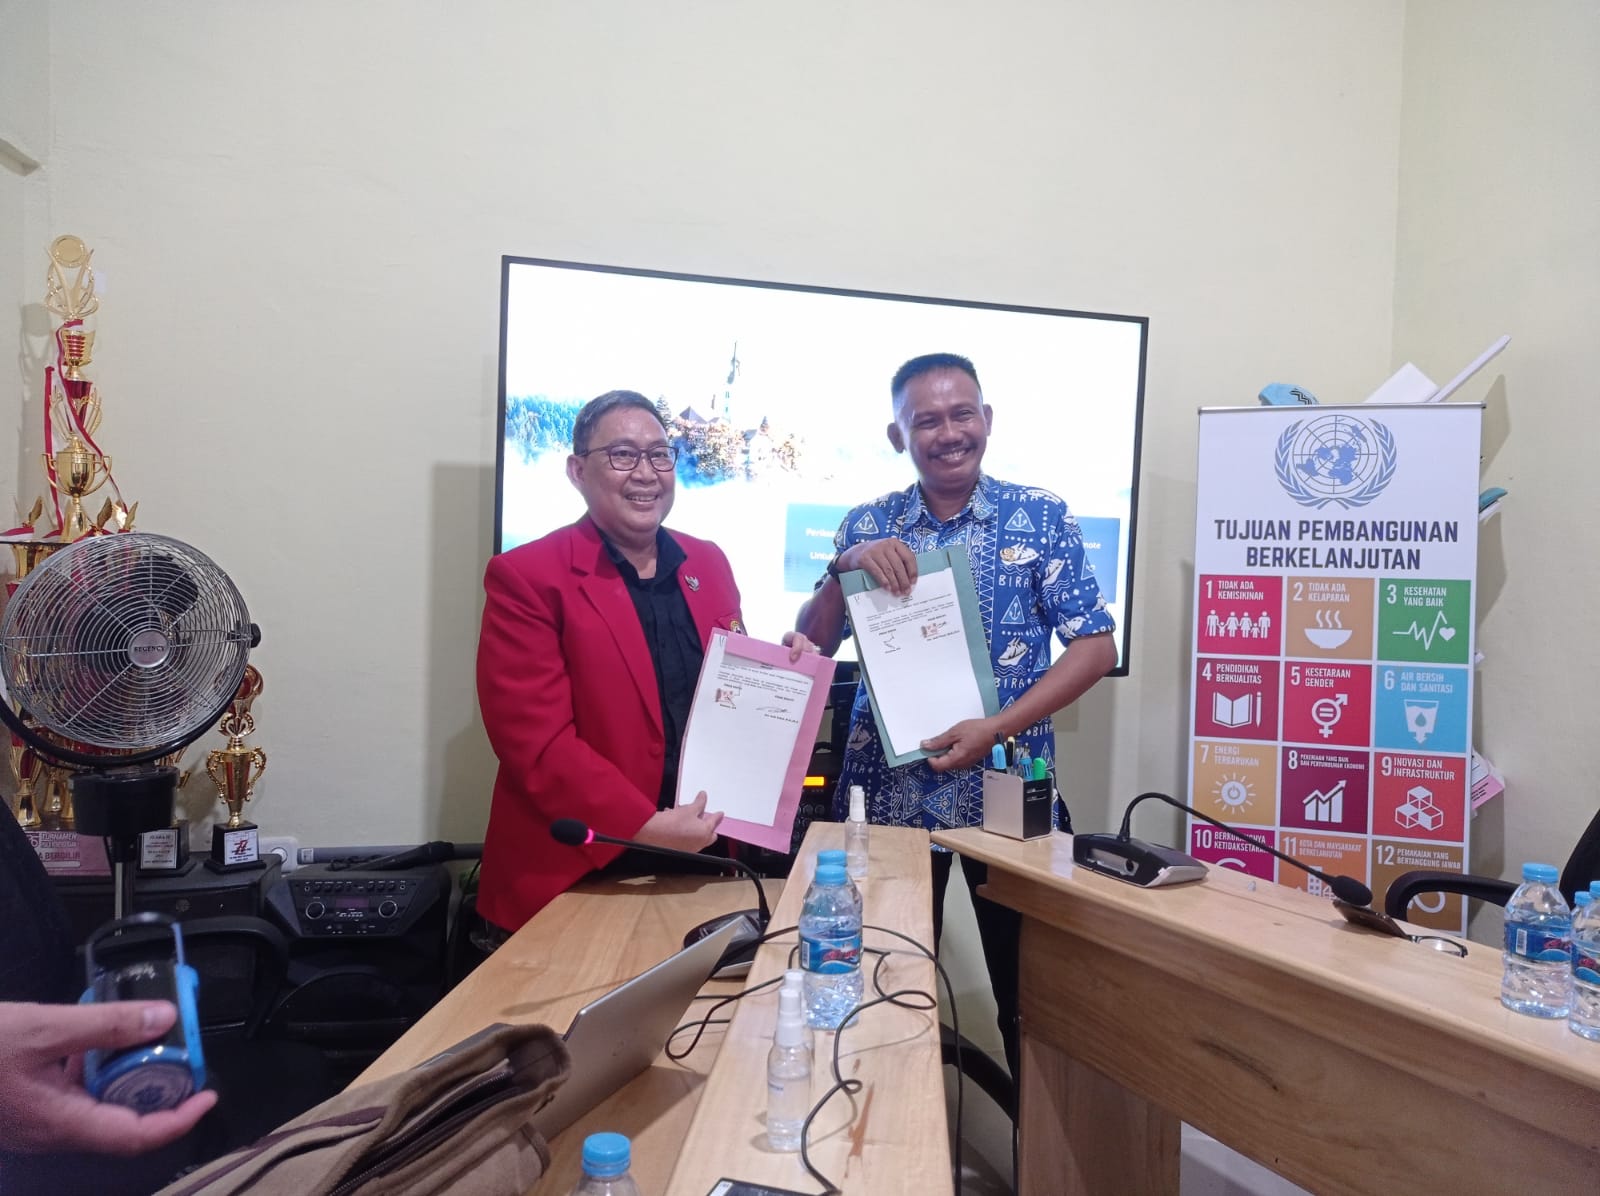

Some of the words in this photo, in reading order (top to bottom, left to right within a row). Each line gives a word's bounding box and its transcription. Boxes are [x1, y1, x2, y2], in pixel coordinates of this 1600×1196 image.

[1214, 519, 1291, 540] TUJUAN
[1298, 520, 1458, 542] PEMBANGUNAN
[1246, 547, 1420, 570] BERKELANJUTAN
[999, 575, 1029, 588] BIRA
[1218, 580, 1238, 590] TIDAK
[1240, 581, 1254, 590] ADA
[1308, 583, 1329, 592] TIDAK
[1331, 583, 1346, 593] ADA
[1206, 580, 1213, 599] 1
[1293, 582, 1304, 601] 2
[1386, 584, 1397, 604] 3
[1404, 587, 1447, 597] KESEHATAN
[1047, 592, 1070, 608] IRA
[1308, 593, 1350, 602] KELAPARAN
[1404, 597, 1423, 606] YANG
[1426, 598, 1444, 607] BAIK
[1202, 662, 1212, 681] 4
[1216, 664, 1259, 674] PENDIDIKAN
[1305, 668, 1351, 678] KESETARAAN
[1216, 674, 1262, 684] BERKUALITAS
[1291, 666, 1300, 686] 5
[1384, 670, 1395, 690] 6
[1400, 672, 1414, 682] AIR
[1416, 673, 1444, 682] BERSIH
[1305, 678, 1334, 688] GENDER
[1400, 682, 1417, 692] DAN
[1420, 683, 1453, 694] SANITASI
[1201, 745, 1209, 764] 7
[1288, 750, 1298, 769] 8
[1382, 756, 1392, 776] 9
[1394, 758, 1424, 768] INOVASI
[1426, 760, 1442, 768] DAN
[1394, 768, 1455, 780] INFRASTRUKTUR
[1194, 828, 1212, 848] 10
[1283, 836, 1296, 856] 11
[1376, 845, 1394, 866] 12
[1397, 848, 1432, 858] PEMAKAIAN
[1433, 852, 1448, 860] YANG
[1397, 856, 1440, 868] BERTANGGUNG
